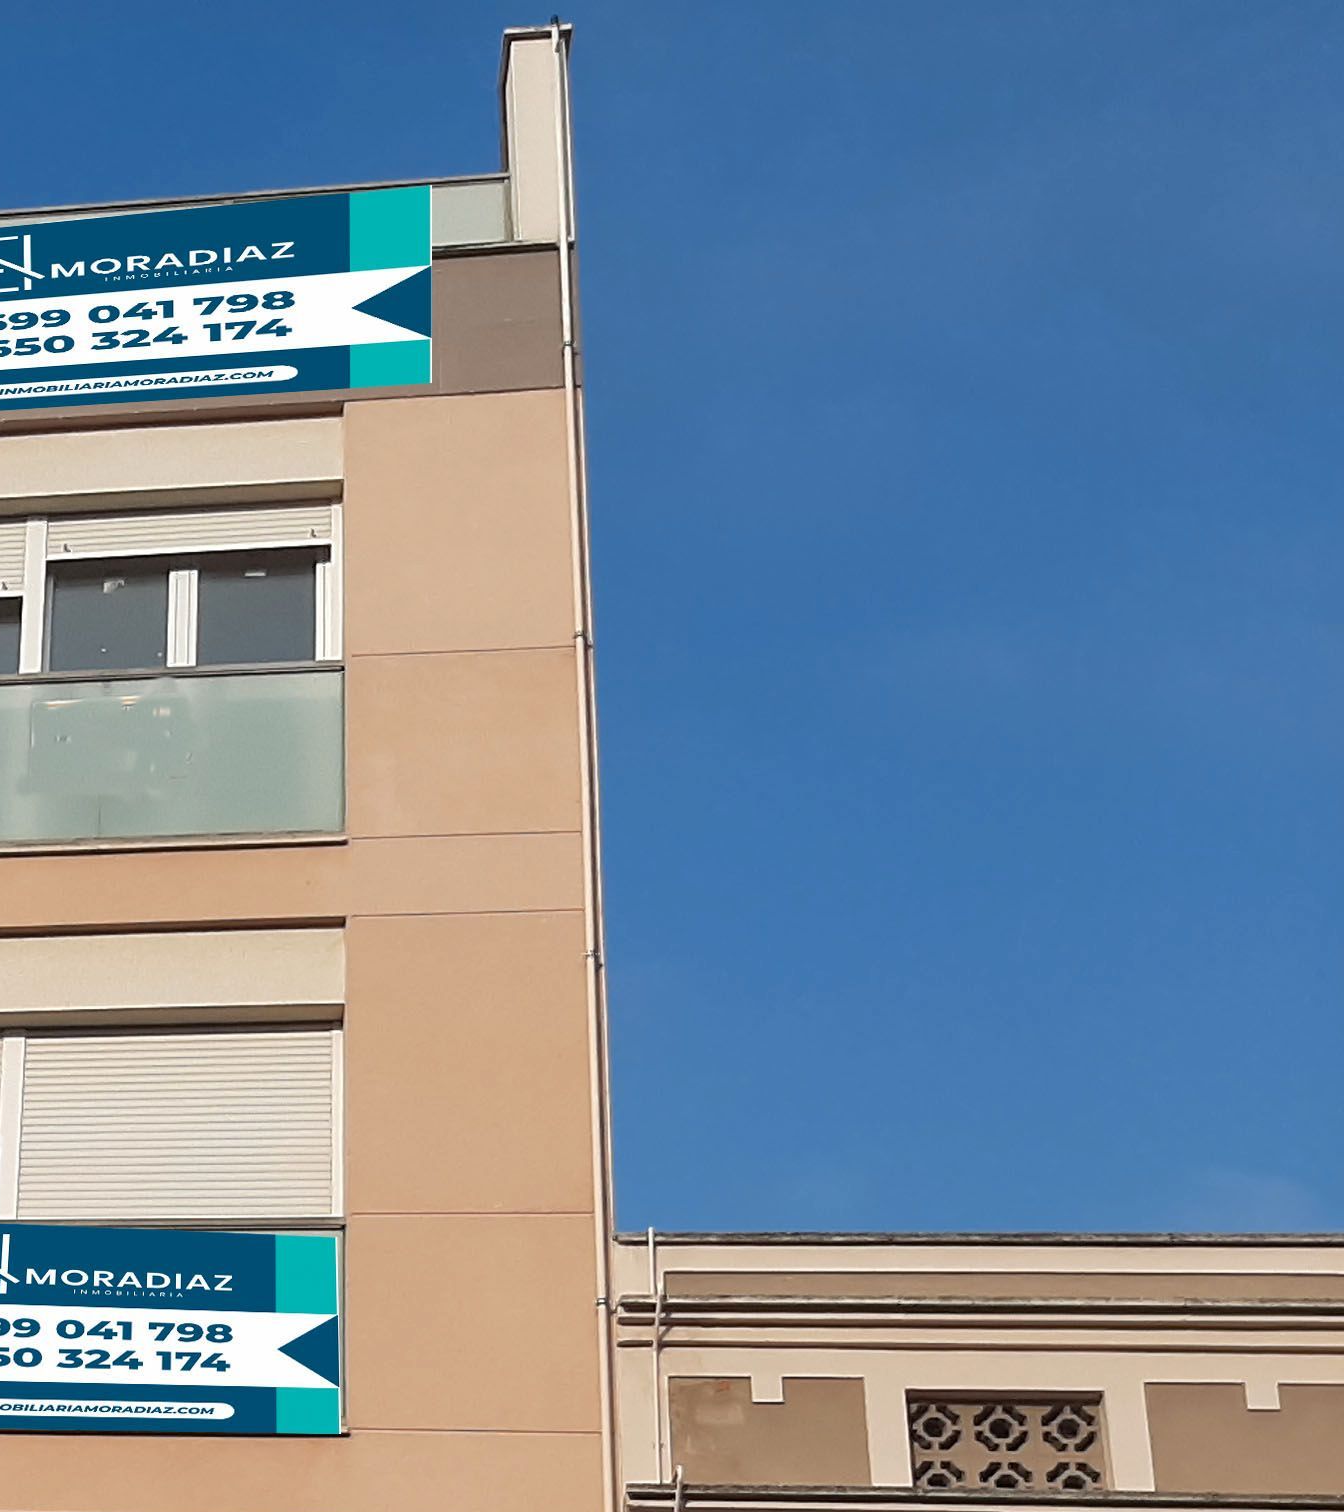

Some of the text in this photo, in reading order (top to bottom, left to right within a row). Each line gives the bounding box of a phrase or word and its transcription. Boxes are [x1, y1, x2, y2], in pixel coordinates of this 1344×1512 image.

[52, 242, 295, 279] MORADIAZ
[89, 300, 174, 323] 041
[194, 291, 295, 315] 798
[91, 327, 188, 350] 324
[203, 319, 292, 341] 174
[25, 1268, 233, 1291] MORADIAZ
[57, 1320, 133, 1340] 041
[149, 1322, 233, 1343] 798
[57, 1349, 144, 1369] 324
[157, 1352, 231, 1371] 174
